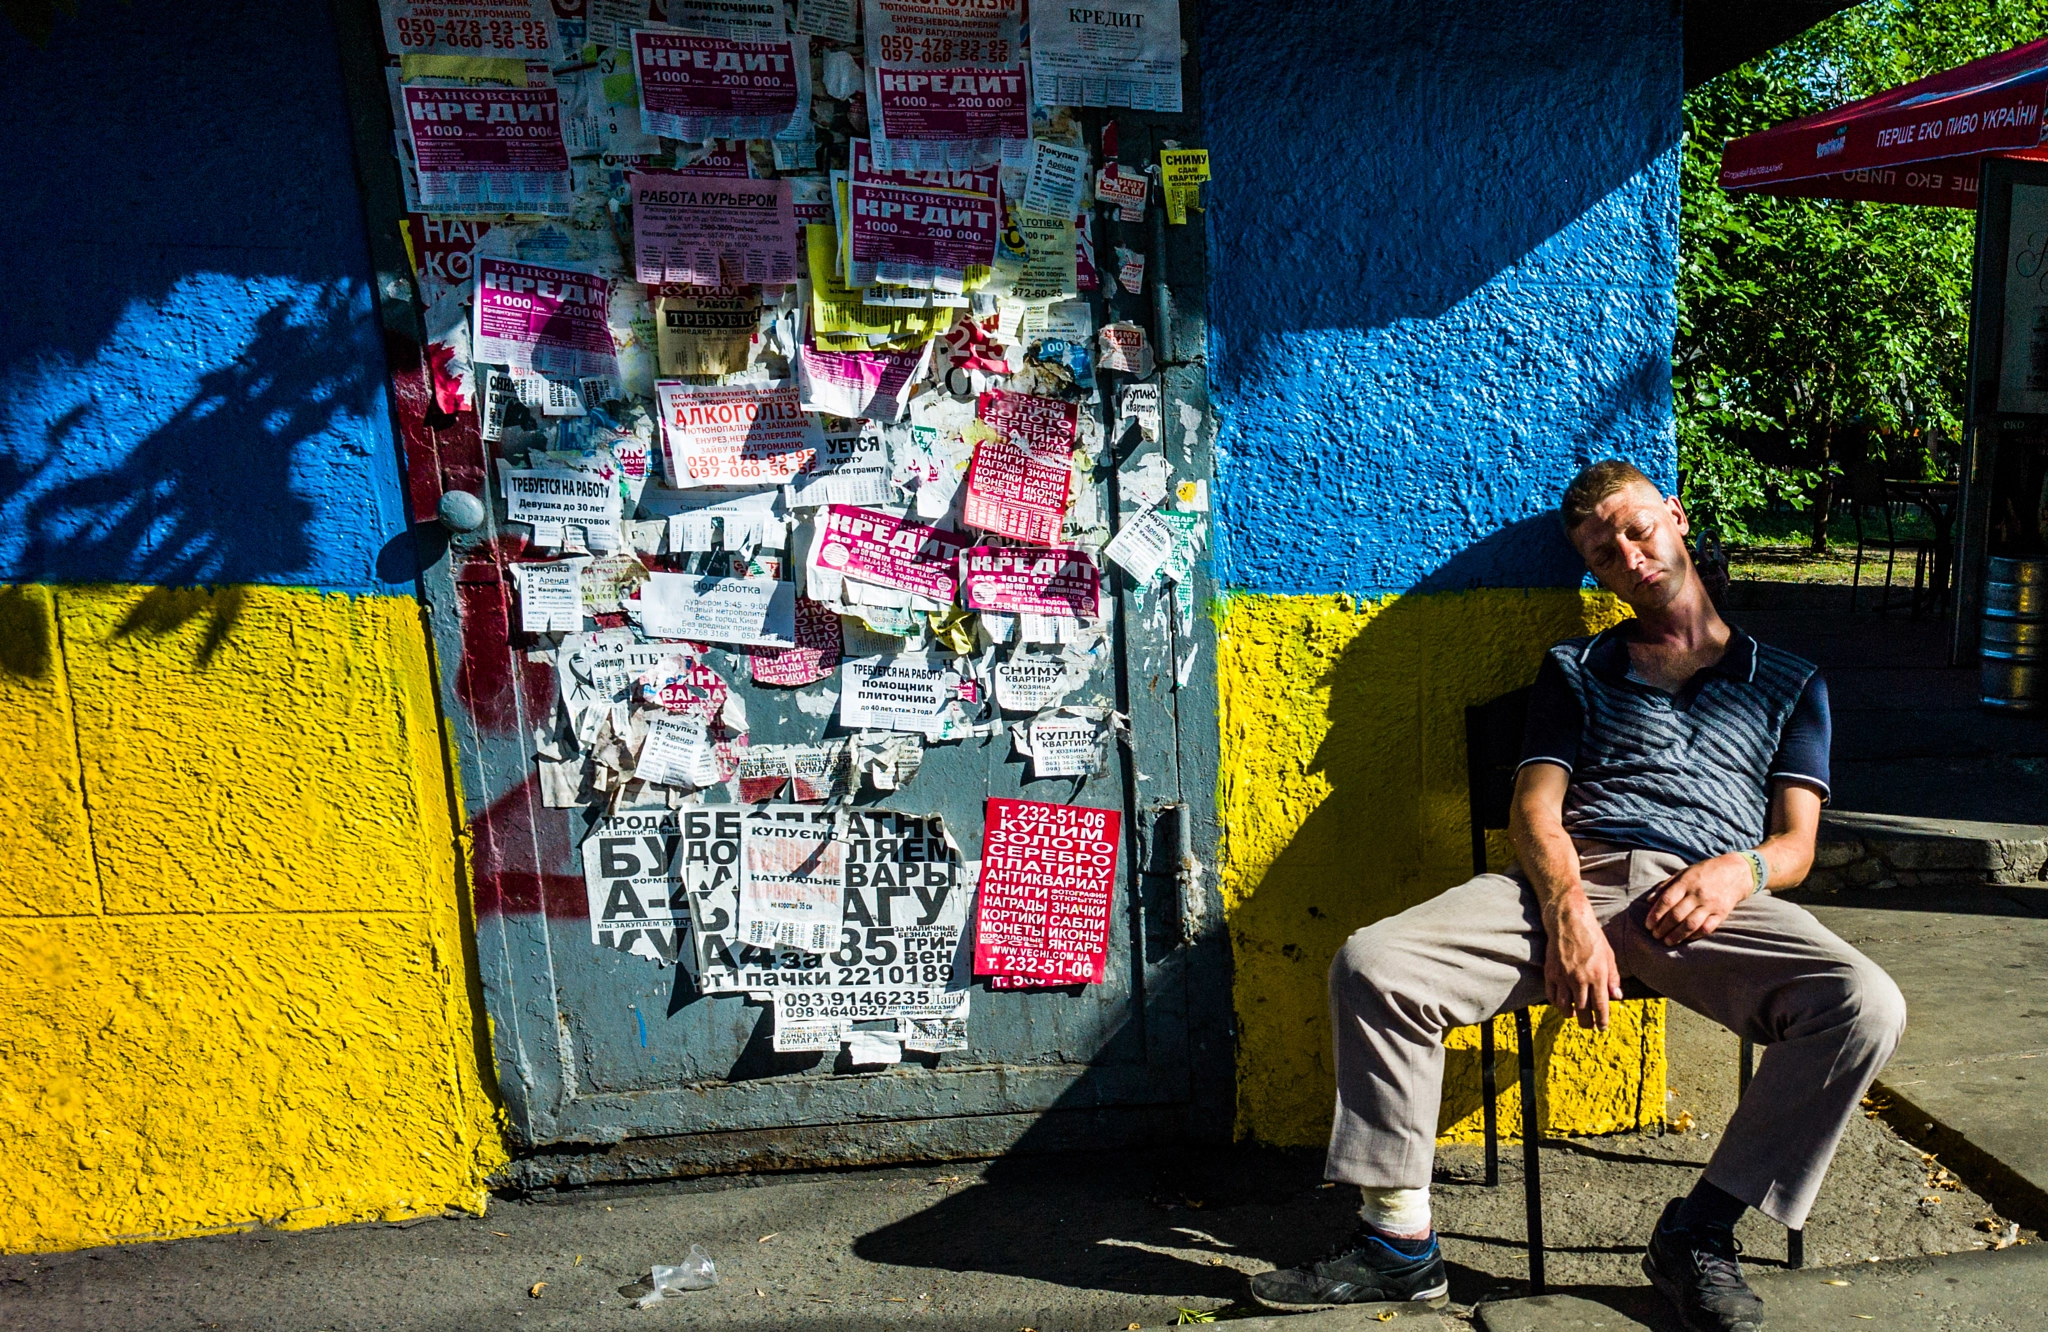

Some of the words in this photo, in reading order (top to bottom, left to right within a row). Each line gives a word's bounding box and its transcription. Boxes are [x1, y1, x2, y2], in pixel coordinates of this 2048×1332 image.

[685, 0, 774, 14] плиточника
[398, 18, 545, 35] 050-478-93-95
[1069, 8, 1144, 29] КРЕДИТ
[401, 33, 548, 48] 097-060-56-56
[881, 35, 1008, 50] 050-478-93-95
[642, 47, 789, 73] КРЕДИТ
[882, 48, 1008, 63] 097-060-56-56
[654, 72, 690, 83] 1000
[722, 75, 749, 85] 200
[753, 76, 780, 86] 000
[884, 74, 1021, 96] КРЕДИТ
[418, 90, 547, 101] БАНКОВСКИЙ
[894, 96, 927, 107] 1000
[957, 97, 983, 108] 200
[987, 98, 1012, 108] 000
[411, 102, 556, 124] КРЕДИТ
[424, 125, 462, 137] 1000
[496, 126, 523, 137] 200
[1877, 125, 1916, 148] ПЕРШЕ
[1918, 120, 1942, 141] ЕКО
[1946, 113, 1979, 136] ПИВО
[1038, 145, 1079, 162] Покупка
[1166, 155, 1207, 165] СНИМУ
[1047, 160, 1076, 172] Аренда
[1168, 174, 1209, 182] КВАРТИРУ
[639, 190, 697, 204] РАБОТА
[702, 192, 777, 207] КУРЬЕРОМ
[865, 189, 982, 209] БАНКОВСКИЙ
[857, 199, 993, 229] КРЕДИТ
[865, 220, 898, 233] 1000
[927, 227, 952, 240] 200
[957, 230, 981, 241] 000
[485, 272, 605, 306] КРЕДИТ
[659, 285, 739, 296] КУПИМ
[494, 294, 531, 309] 1000
[564, 305, 590, 317] 200
[697, 300, 743, 309] РАБОТА
[984, 407, 1072, 428] ЗОЛОТО
[983, 417, 1070, 436] СЕРЕБРО
[687, 449, 816, 466] 050-478-93-95
[979, 449, 1025, 465] КНИГИ
[978, 458, 1024, 475] НАГРАДЫ
[1026, 468, 1065, 483] ЗНАЧКИ
[974, 474, 1020, 491] МОНЕТЫ
[1023, 485, 1063, 500] ИКОНЫ
[975, 466, 1022, 484] КОРТИКИ
[1024, 478, 1065, 492] САБЛИ
[512, 477, 561, 495] ТРЕБУЕТСЯ
[562, 481, 575, 495] НА
[576, 481, 610, 499] РАБОТУ
[519, 499, 562, 511] Девушка
[563, 502, 576, 511] до
[578, 503, 588, 512] 30
[590, 505, 605, 513] лет
[1022, 494, 1061, 508] ЯНТАРЬ
[528, 513, 565, 525] раздачу
[568, 517, 610, 526] листовок
[859, 514, 930, 535] БЫСТРЫЙ
[829, 512, 960, 561] КРЕДИТ
[855, 538, 886, 553] 100
[889, 549, 922, 563] 000
[999, 551, 1068, 559] БЫСТРЫЙ
[526, 565, 570, 578] Покупка
[971, 556, 1093, 580] КРЕДИТ
[539, 577, 569, 585] Аренда
[694, 580, 761, 595] Подработка
[1069, 581, 1091, 589] ГРН
[740, 617, 758, 625] Киев
[658, 626, 674, 634] Тел.
[755, 653, 802, 666] КНИГИ
[757, 662, 804, 675] НАГРАДЫ
[853, 664, 897, 678] ТРЕБУЕТСЯ
[898, 668, 909, 678] НА
[911, 669, 943, 681] РАБОТУ
[1000, 666, 1063, 675] СНИМУ
[862, 680, 933, 693] помощник
[1005, 675, 1058, 684] КВАРТИРУ
[858, 691, 936, 705] плиточника
[657, 719, 698, 735] Покупка
[665, 732, 694, 745] Аренда
[1036, 730, 1098, 741] КУПЛЮ
[1042, 740, 1094, 748] КВАРТИРУ
[1018, 805, 1105, 828] 232-51-06
[752, 827, 839, 840] КУПУЄМО
[1001, 819, 1103, 840] КУПИМ
[990, 831, 1113, 853] ЗОЛОТО
[988, 843, 1111, 867] СЕРЕБРО
[986, 856, 1111, 879] ПЛАТИНУ
[751, 874, 841, 886] НАТУРАЛЬНЕ
[986, 869, 1109, 892] АНТИКВАРИАТ
[985, 882, 1048, 899] КНИГИ
[1051, 889, 1107, 899] ФОТОГРАФИИ
[983, 896, 1047, 913] НАГРАДЫ
[1052, 902, 1106, 918] ЗНАЧКИ
[1051, 895, 1107, 905] ОТКРЫТКИ
[982, 909, 1046, 927] КОРТИКИ
[1050, 915, 1105, 930] САБЛИ
[980, 922, 1045, 937] МОНЕТЫ
[1048, 928, 1104, 942] ИКОНЫ
[980, 933, 1043, 943] КОРАЛЛОВЫЕ
[830, 927, 897, 967] 85
[905, 938, 957, 950] ГРИ-
[980, 938, 1043, 948] БУСЫ
[1048, 940, 1102, 954] ЯНТАРЬ
[904, 951, 951, 965] вен
[992, 945, 1090, 962] WWW.VECHI.COM.UA
[1005, 956, 1093, 977] 232-51-06
[746, 970, 831, 986] пачки
[838, 964, 954, 986] 2210189
